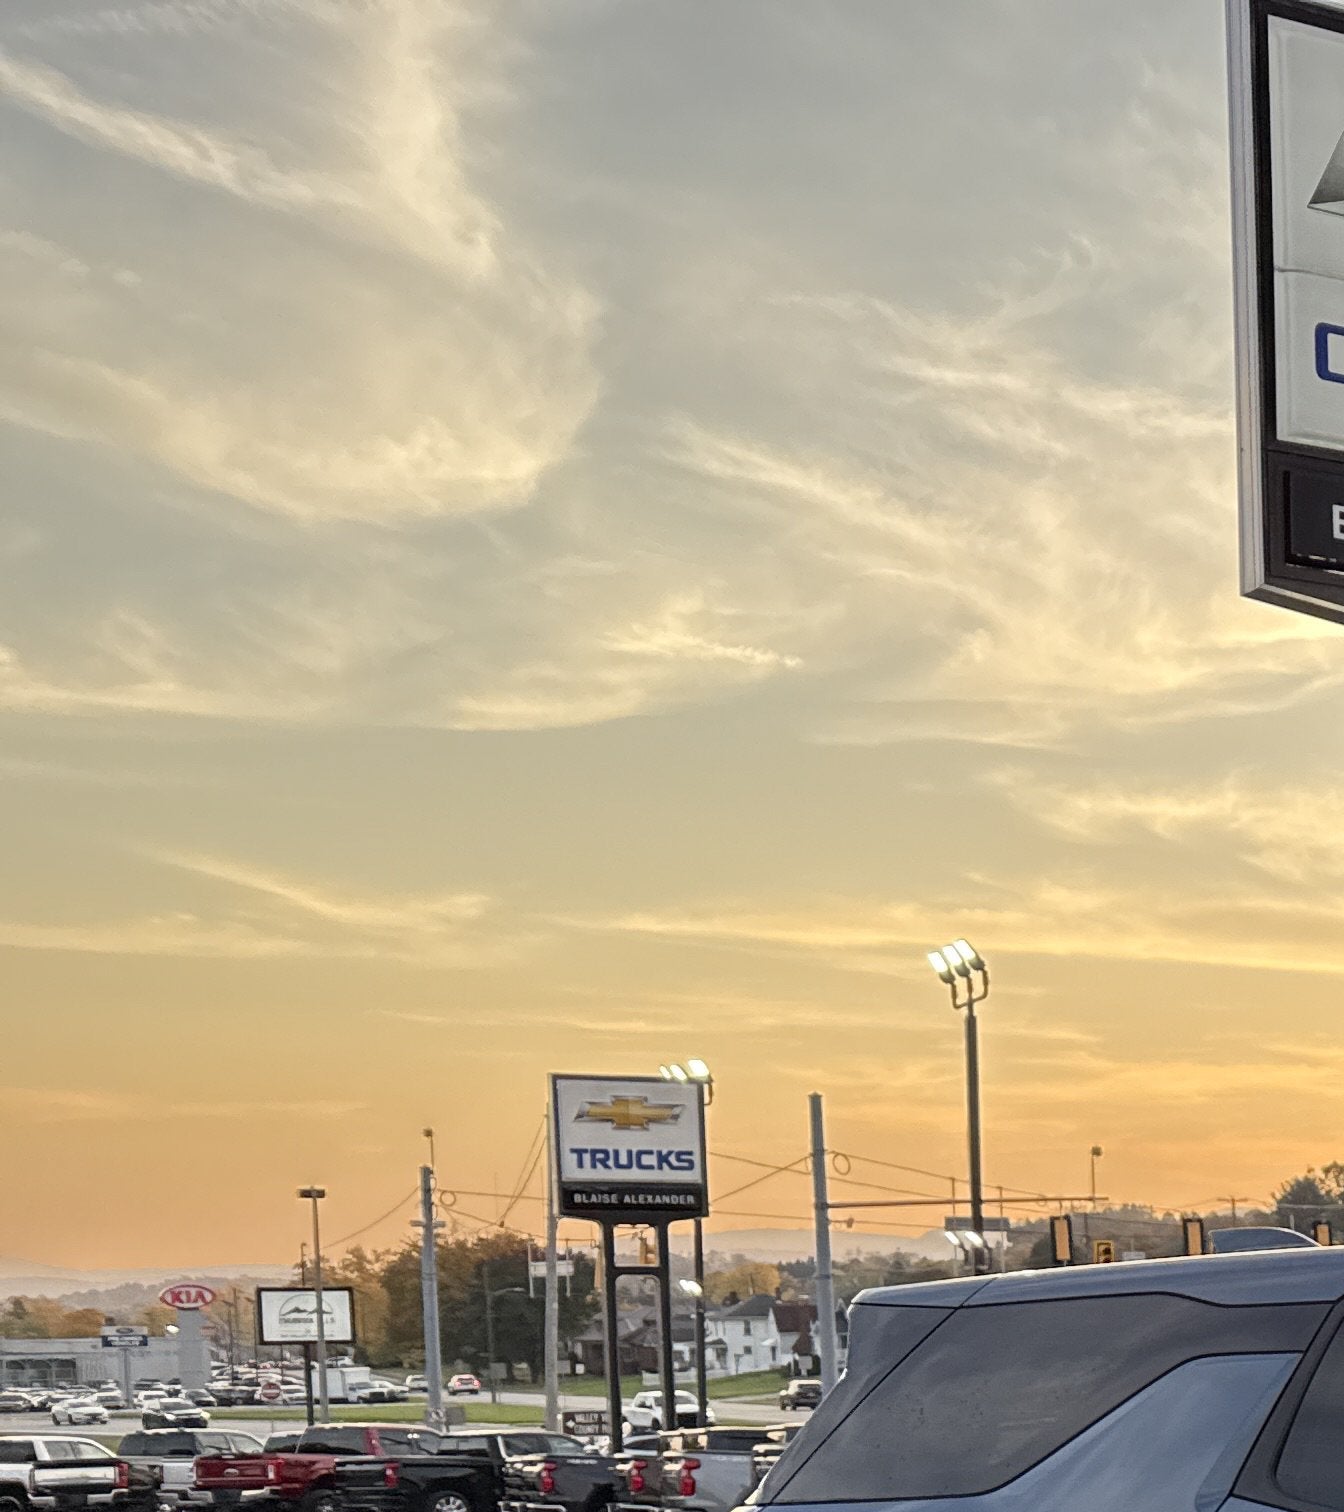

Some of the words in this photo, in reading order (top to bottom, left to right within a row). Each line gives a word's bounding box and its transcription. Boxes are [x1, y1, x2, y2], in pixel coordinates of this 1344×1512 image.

[569, 1147, 695, 1171] TRUCKS
[573, 1193, 618, 1204] BLAISE
[623, 1194, 695, 1205] ALEXANDER
[169, 1289, 209, 1304] KIA
